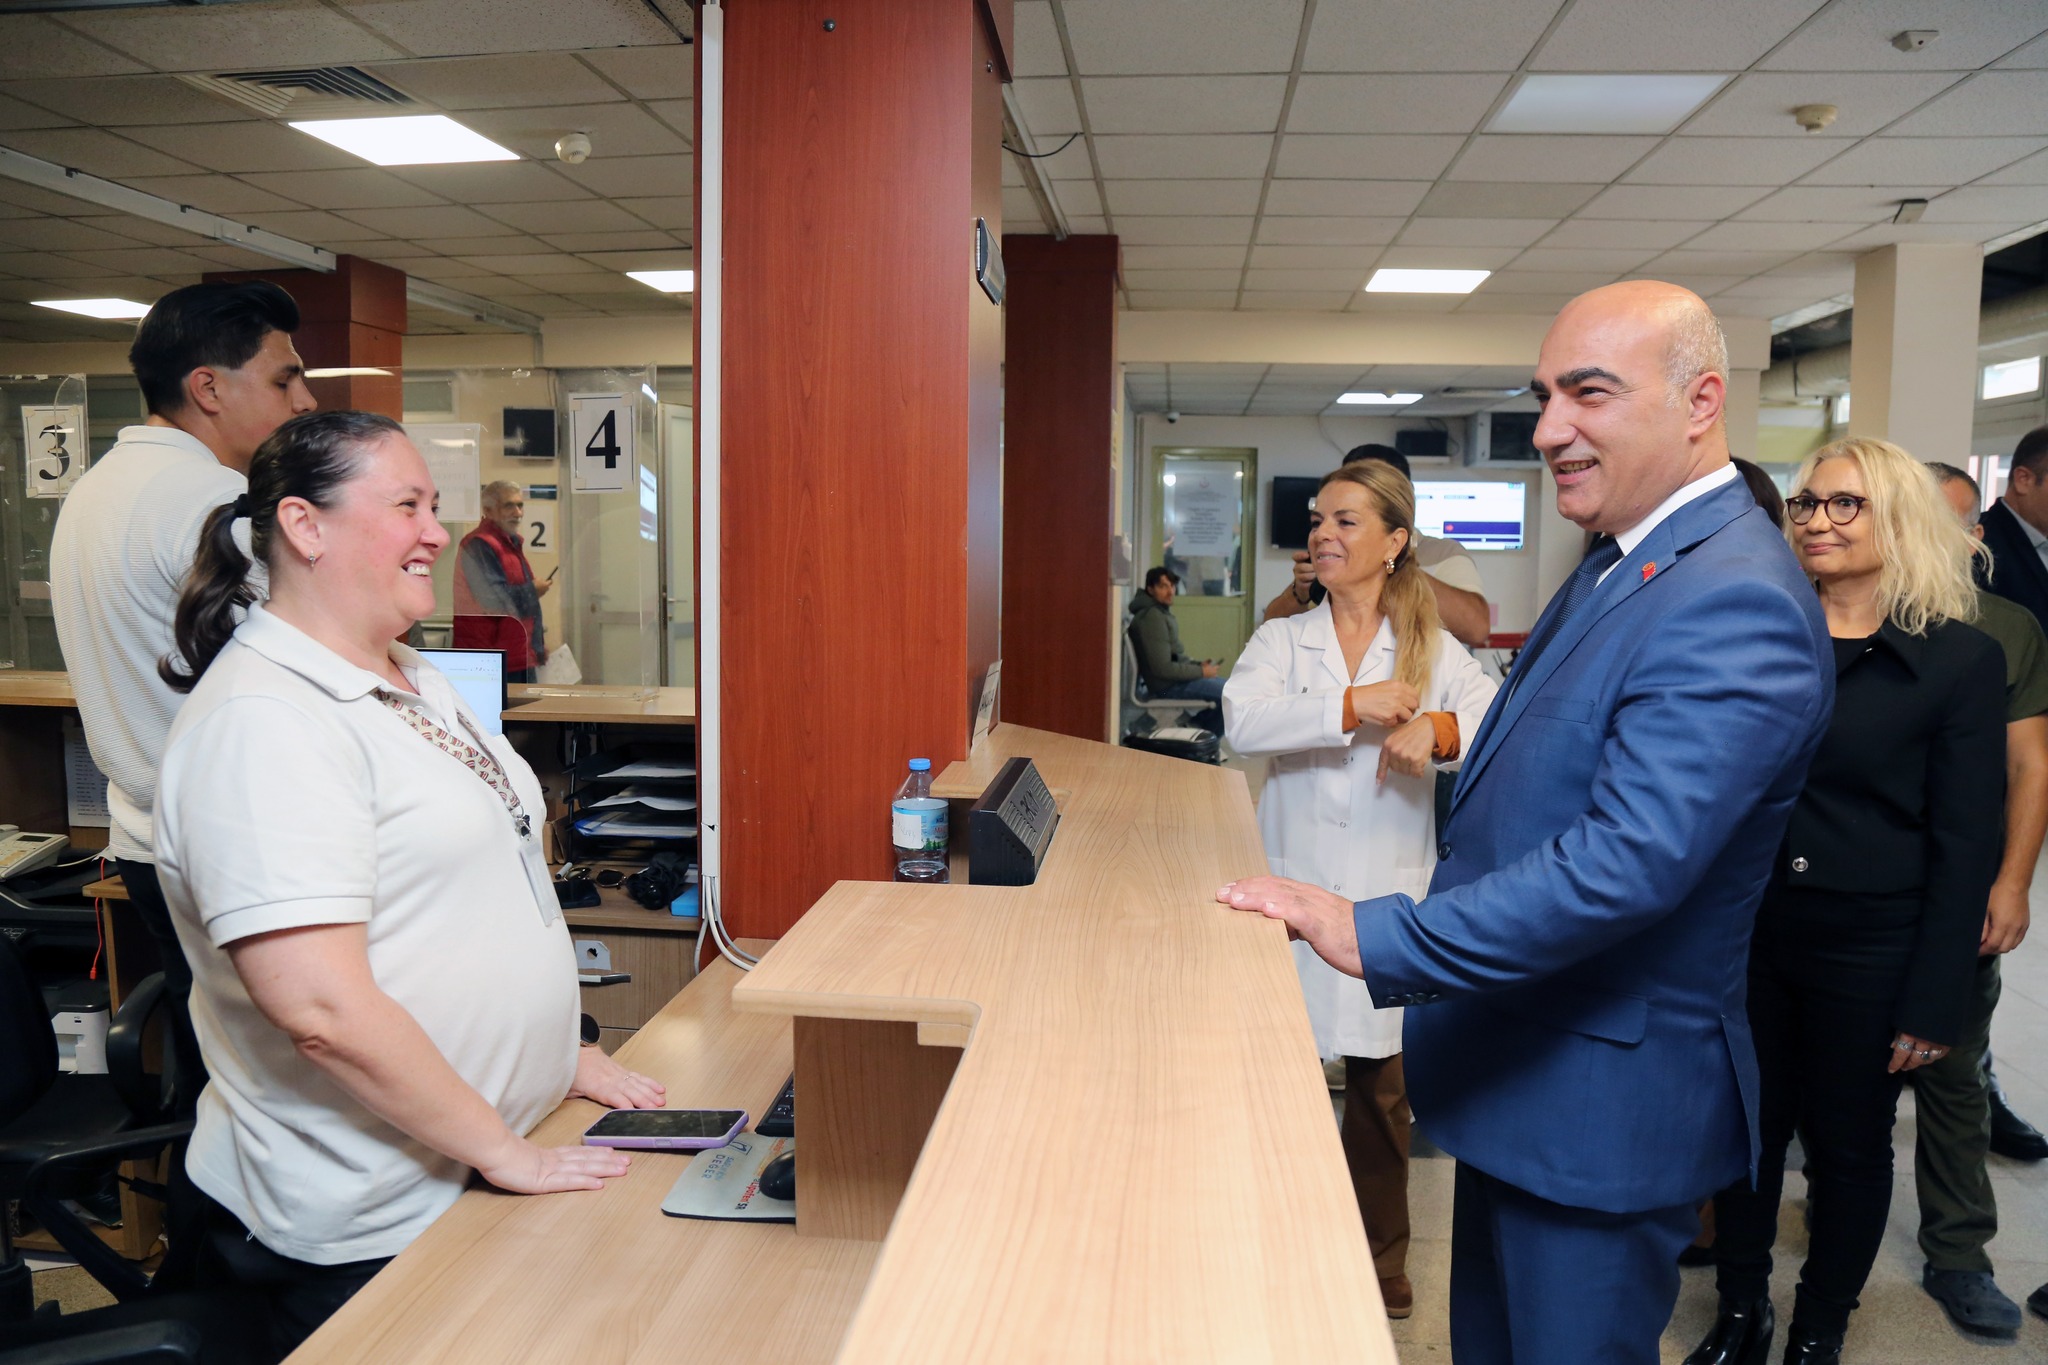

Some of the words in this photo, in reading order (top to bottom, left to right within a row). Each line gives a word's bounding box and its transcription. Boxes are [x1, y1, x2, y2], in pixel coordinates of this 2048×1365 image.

[39, 424, 70, 480] 3
[586, 410, 621, 469] 4
[530, 521, 547, 547] 2
